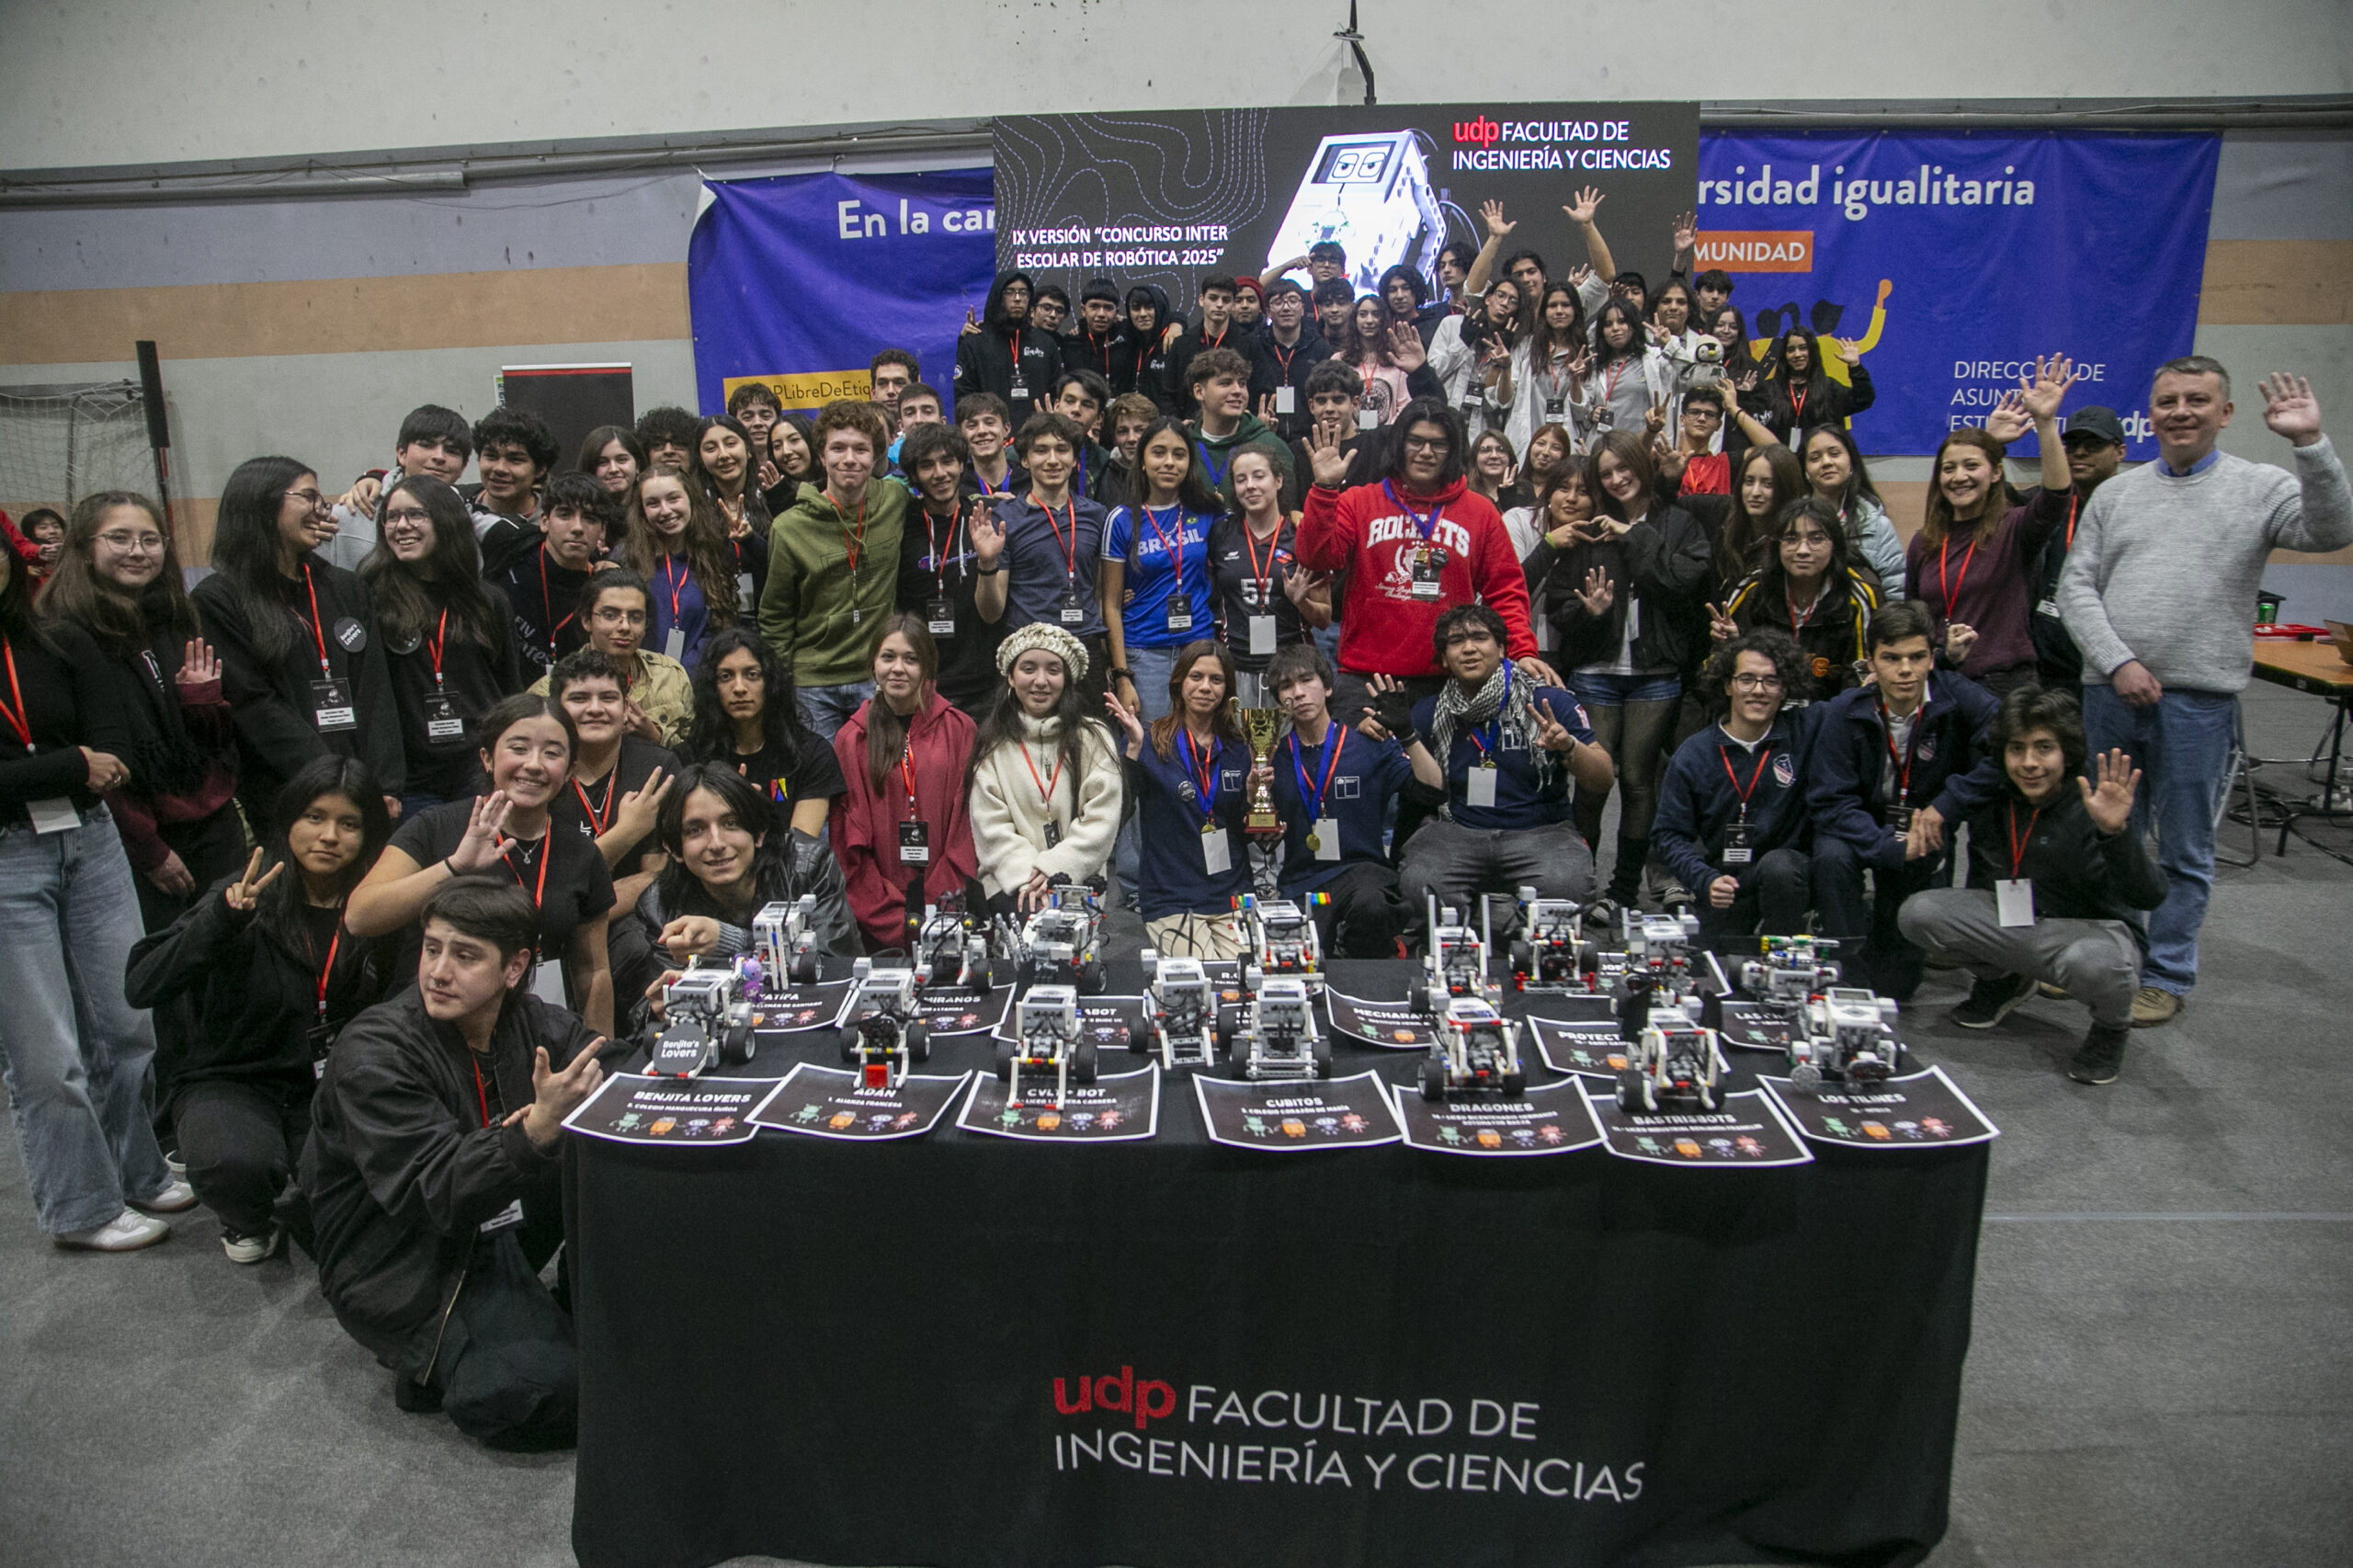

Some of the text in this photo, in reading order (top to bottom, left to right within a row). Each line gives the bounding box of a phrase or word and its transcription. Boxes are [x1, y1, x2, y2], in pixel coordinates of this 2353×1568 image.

[1453, 115, 1630, 149] udp FACULTAD DE
[1452, 144, 1671, 170] INGENIERÍA Y CIENCIAS
[1698, 164, 2035, 221] rsidad igualitaria
[837, 199, 887, 240] En
[899, 199, 929, 235] la
[1012, 230, 1027, 245] IX
[1029, 225, 1090, 244] VERSIÓN
[1186, 225, 1229, 242] INTER
[1017, 252, 1079, 268] ESCOLAR
[1083, 251, 1102, 267] DE
[1105, 247, 1178, 267] ROBÓTICA
[2077, 363, 2106, 381] DE
[2117, 410, 2155, 443] dp
[1137, 528, 1204, 556] BRASIL
[1241, 577, 1273, 605] 57
[661, 1048, 698, 1058] Lovers
[663, 1039, 699, 1051] Benjita's
[633, 1091, 752, 1104] BENJITA LOVERS
[1077, 1088, 1107, 1097] BOT
[1265, 1097, 1324, 1108] CUBITOS
[1449, 1103, 1535, 1113] DRAGONES
[1053, 1366, 1540, 1440] udp FACULTAD DE
[1054, 1428, 1645, 1503] INGENIERÍA Y CIENCIAS
